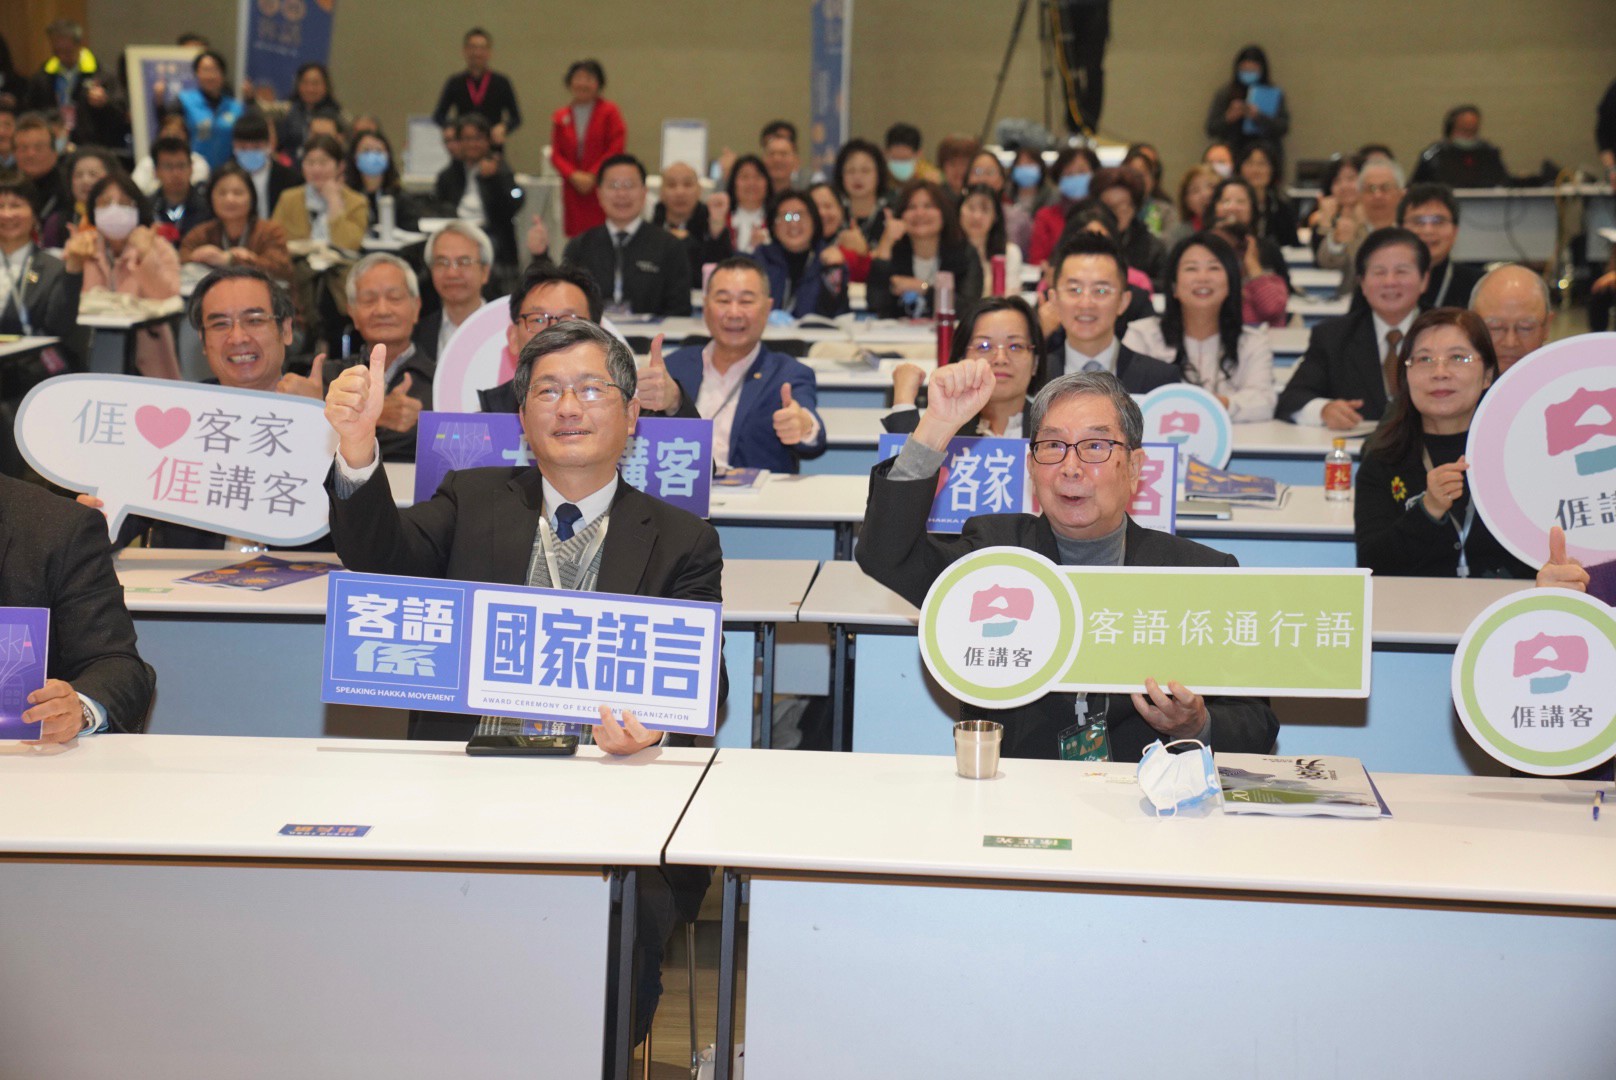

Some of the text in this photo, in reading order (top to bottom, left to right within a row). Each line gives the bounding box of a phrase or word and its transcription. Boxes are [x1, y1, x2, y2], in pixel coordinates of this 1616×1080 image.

[193, 408, 295, 457] 客家
[948, 447, 1016, 513] 客家
[346, 593, 455, 643] 客語
[1087, 608, 1356, 649] 客語係通行語
[353, 640, 438, 677] 係
[483, 602, 706, 700] 國家語言
[335, 686, 456, 702] SPEAKING HAKKA MOVEMENT
[483, 697, 512, 705] AWARD
[514, 699, 560, 709] CEREMONY
[576, 705, 623, 715] EXCENT
[627, 709, 690, 721] RGANIZATION
